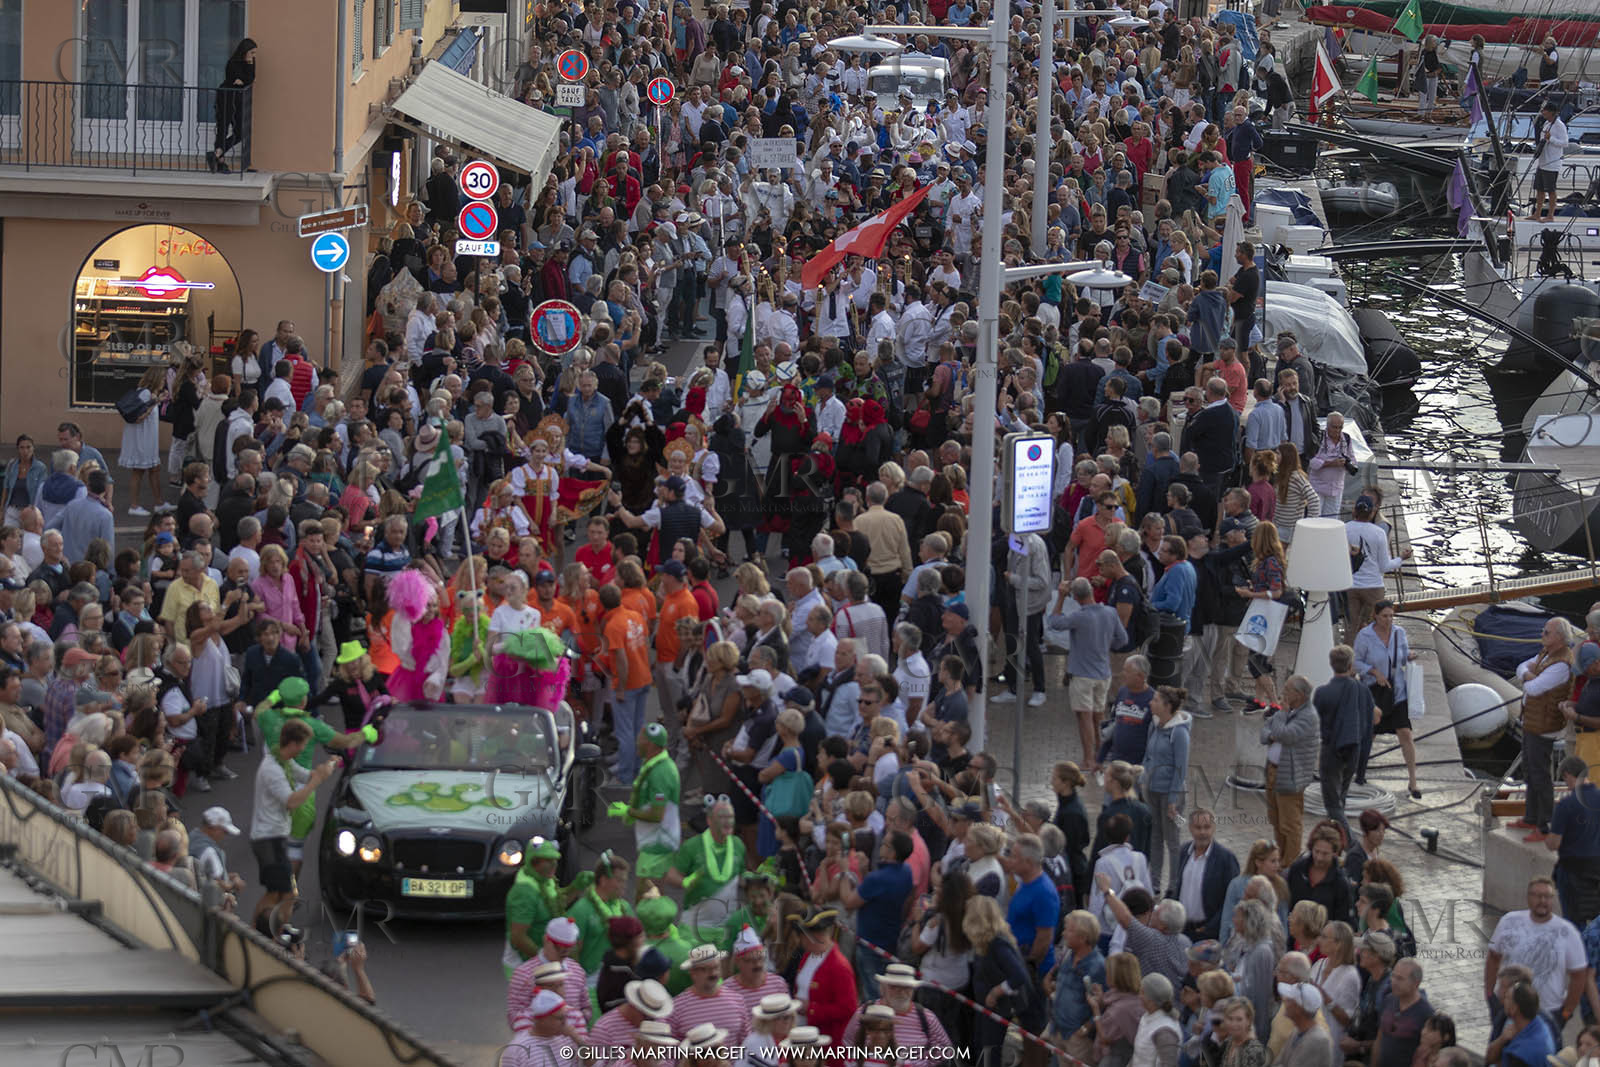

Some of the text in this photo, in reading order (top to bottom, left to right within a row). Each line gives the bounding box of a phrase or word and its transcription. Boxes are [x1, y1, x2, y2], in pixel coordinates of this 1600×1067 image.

[562, 96, 580, 104] TAXIS
[468, 172, 491, 188] 30
[158, 240, 216, 256] STAGE
[458, 243, 482, 252] SAUF
[411, 880, 424, 892] BA
[427, 881, 447, 893] 321
